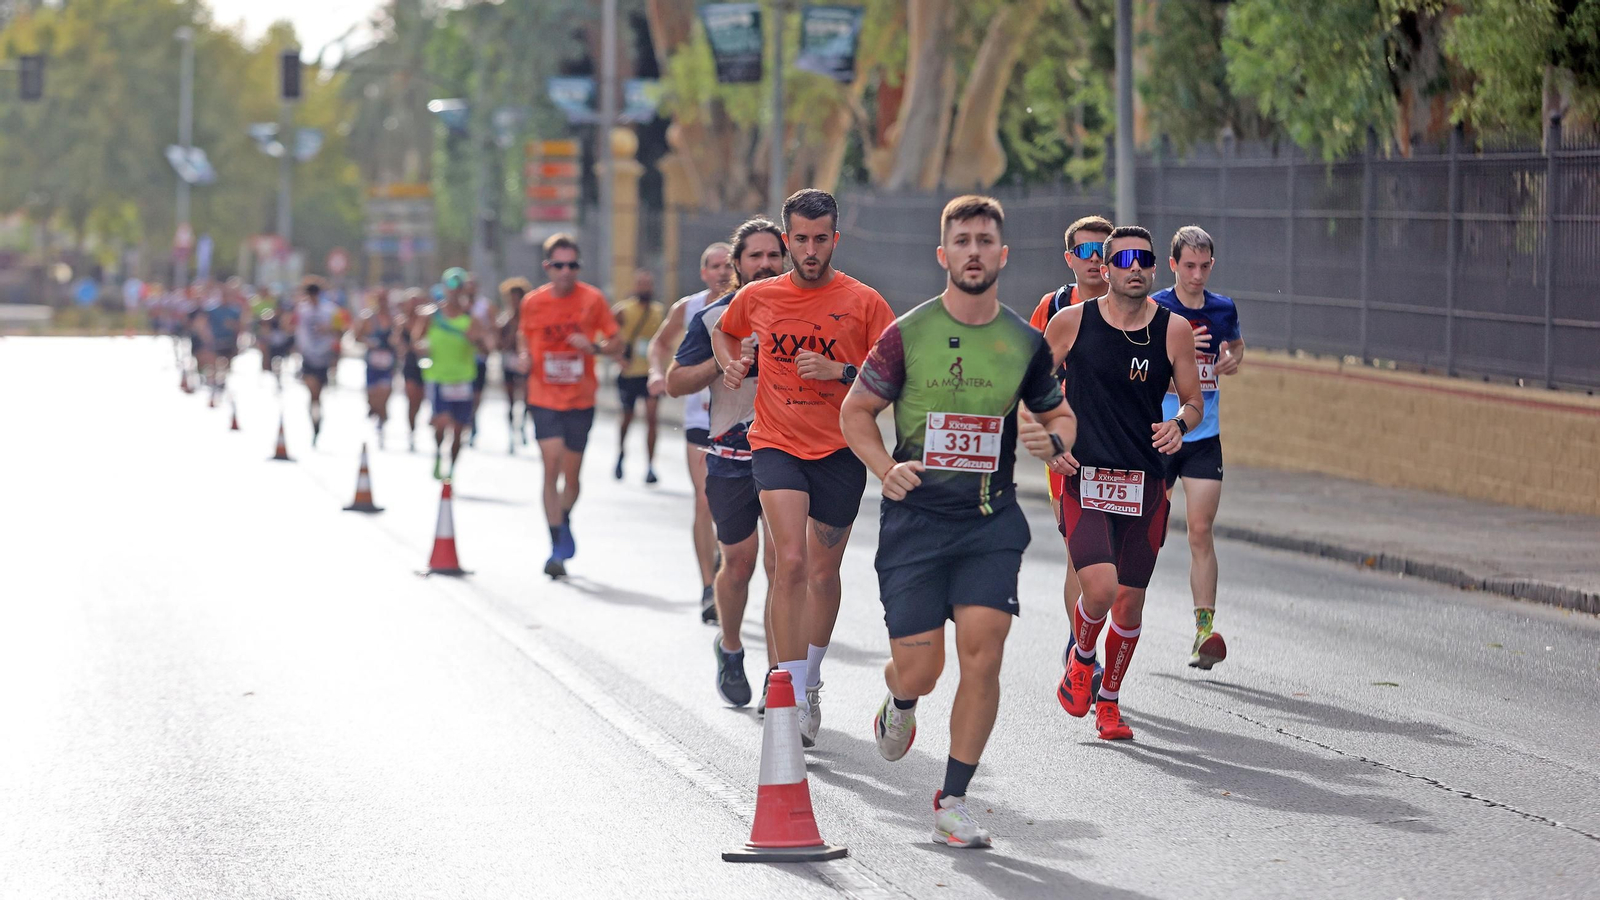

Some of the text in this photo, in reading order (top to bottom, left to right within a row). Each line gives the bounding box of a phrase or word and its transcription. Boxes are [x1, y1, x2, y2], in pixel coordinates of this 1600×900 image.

[927, 378, 993, 388] LA MONTERA
[945, 433, 981, 453] 331
[1097, 483, 1127, 500] 175
